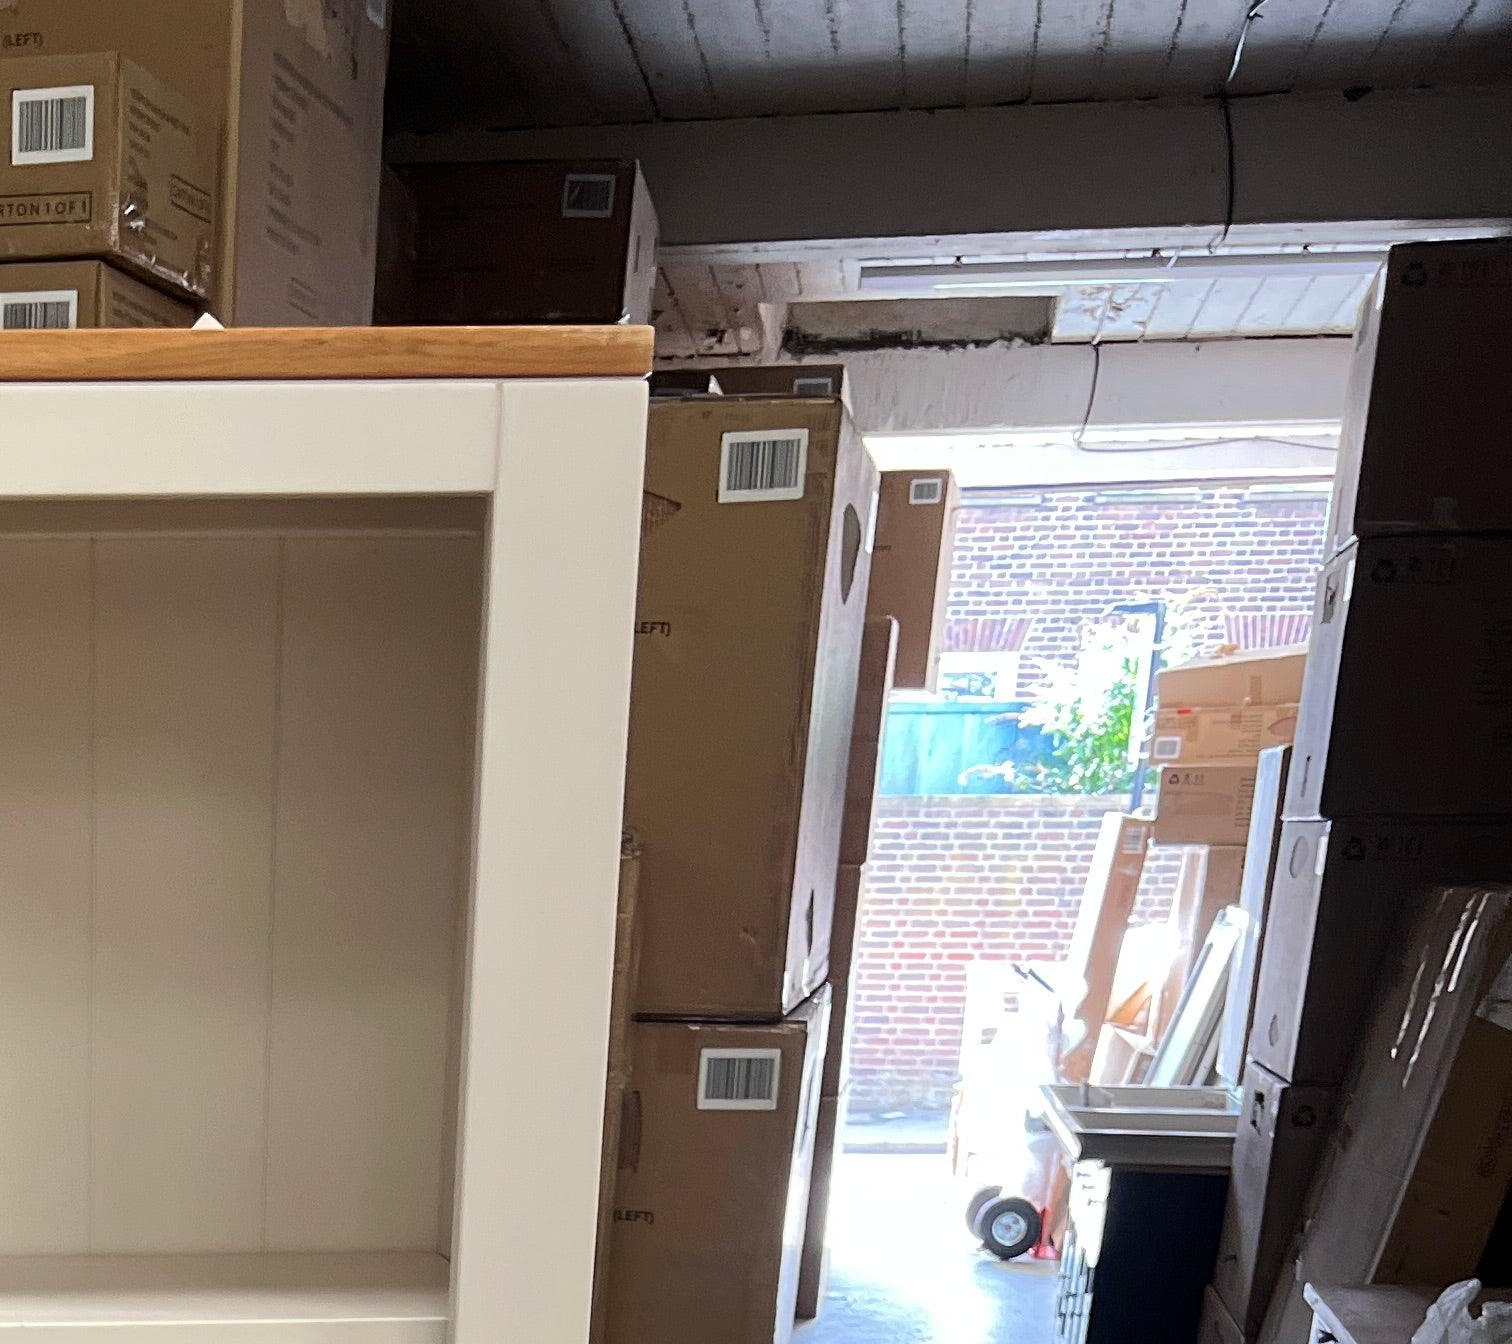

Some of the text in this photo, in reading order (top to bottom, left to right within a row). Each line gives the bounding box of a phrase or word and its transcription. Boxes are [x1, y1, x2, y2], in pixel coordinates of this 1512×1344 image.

[3, 31, 44, 49] (LEFT)
[54, 200, 77, 215] OF
[613, 1208, 655, 1225] (LEFT)
